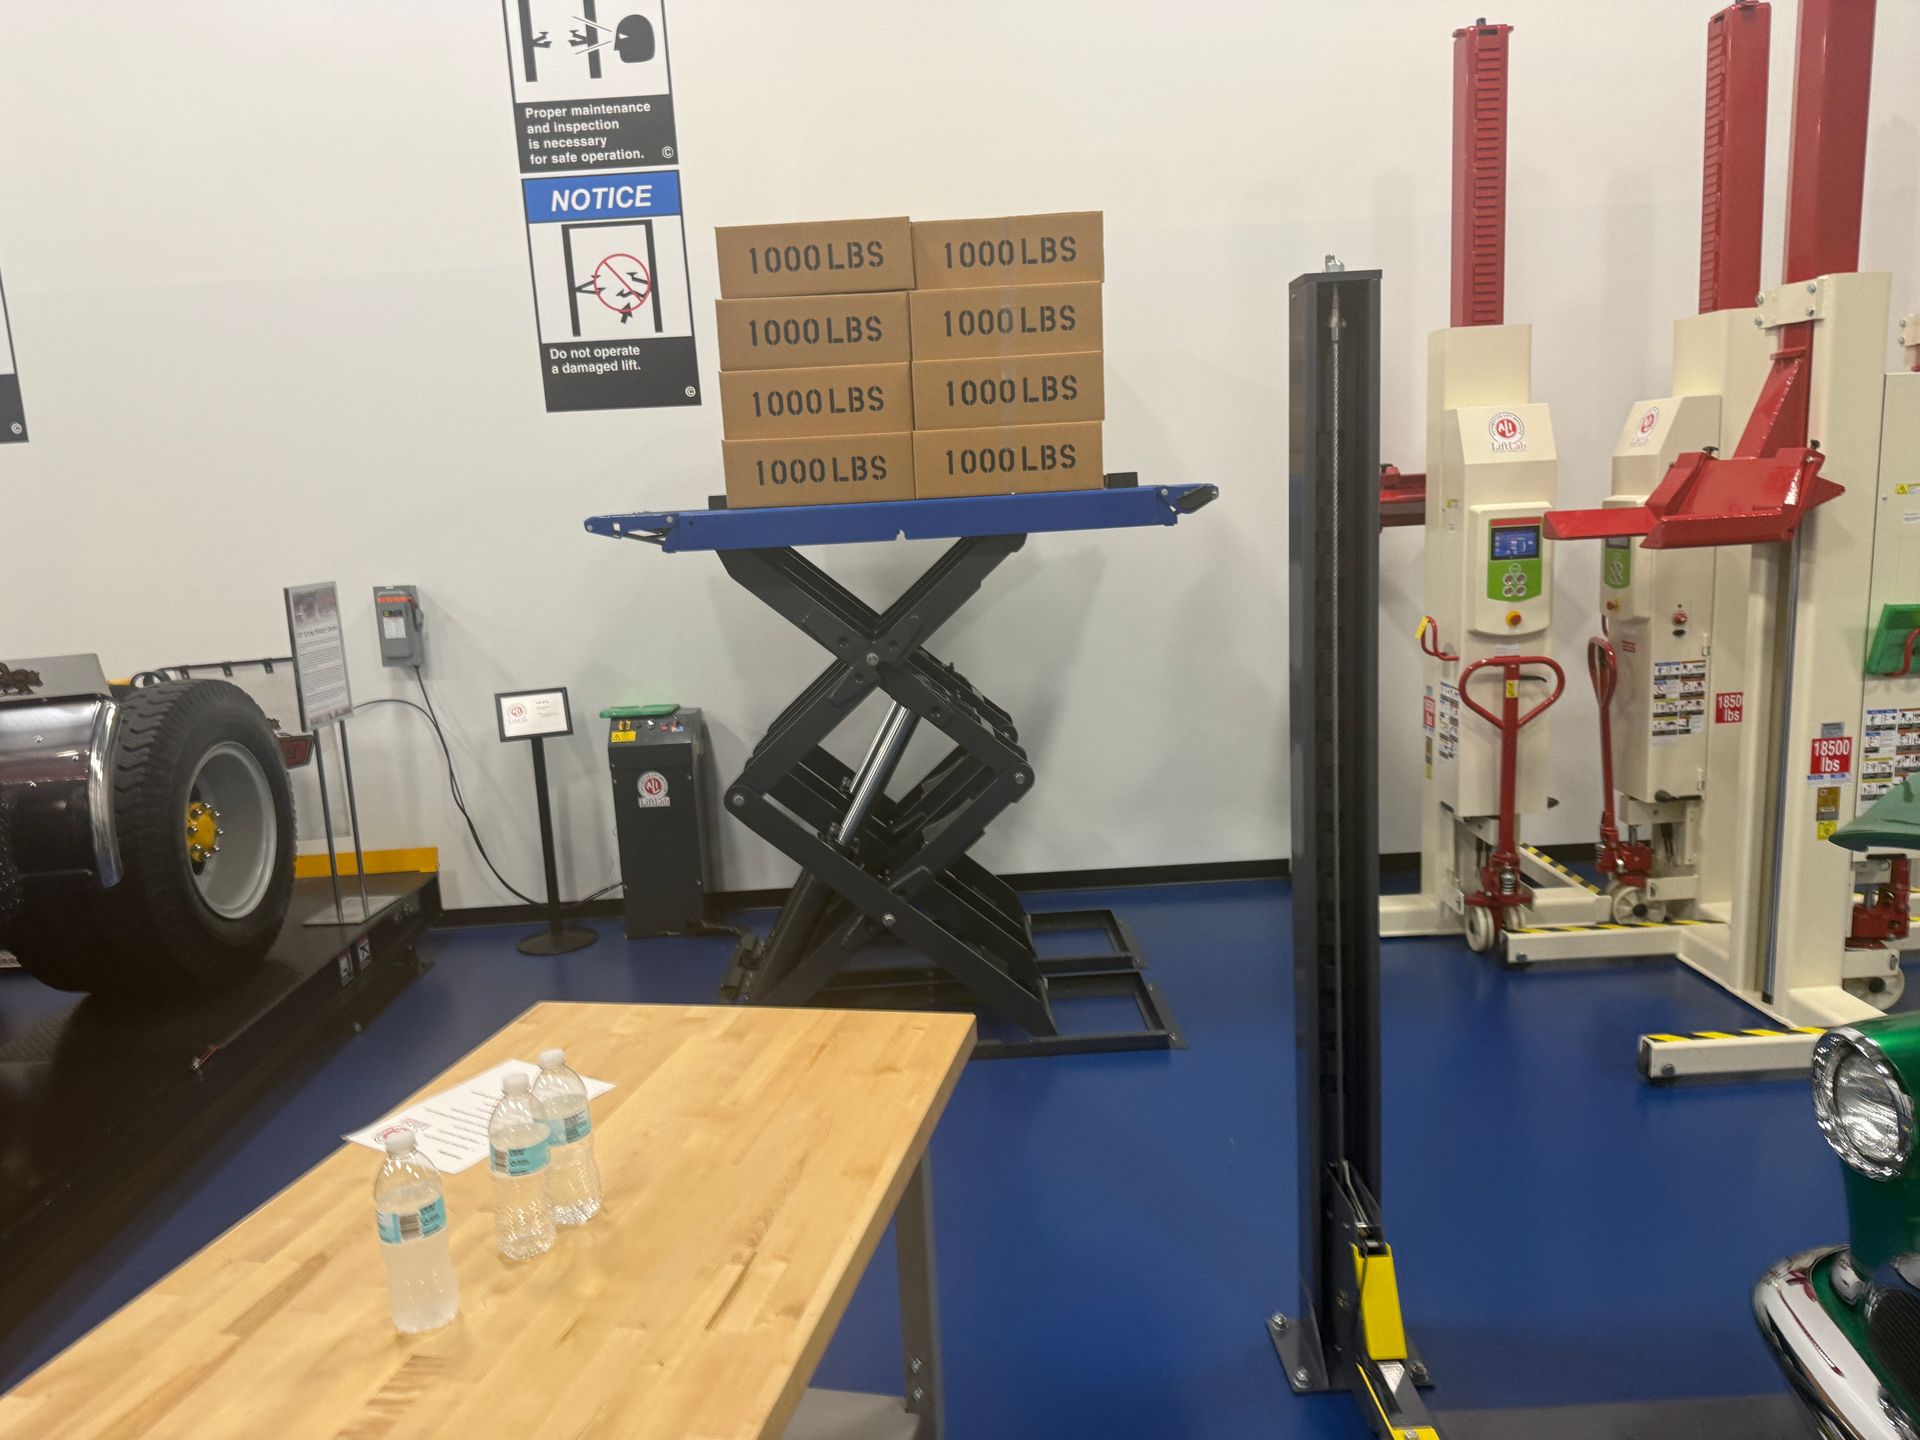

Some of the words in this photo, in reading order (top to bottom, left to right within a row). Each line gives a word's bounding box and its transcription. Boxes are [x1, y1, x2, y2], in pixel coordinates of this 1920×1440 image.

[525, 107, 567, 119] Proper
[571, 102, 651, 116] maintenance
[526, 122, 550, 134] and
[553, 119, 619, 133] inspection
[528, 139, 540, 149] is
[543, 136, 607, 149] necessary
[530, 154, 547, 164] for
[550, 152, 578, 164] safe
[581, 149, 645, 163] operation.
[552, 185, 652, 212] NOTICE
[550, 349, 568, 359] Do
[570, 348, 590, 358] not
[594, 345, 640, 358] operate
[552, 365, 559, 374] a
[562, 362, 618, 375] damaged
[621, 360, 641, 371] lift.
[1724, 708, 1740, 721] lbs
[1814, 740, 1850, 757] 18500
[1821, 757, 1840, 772] lbs
